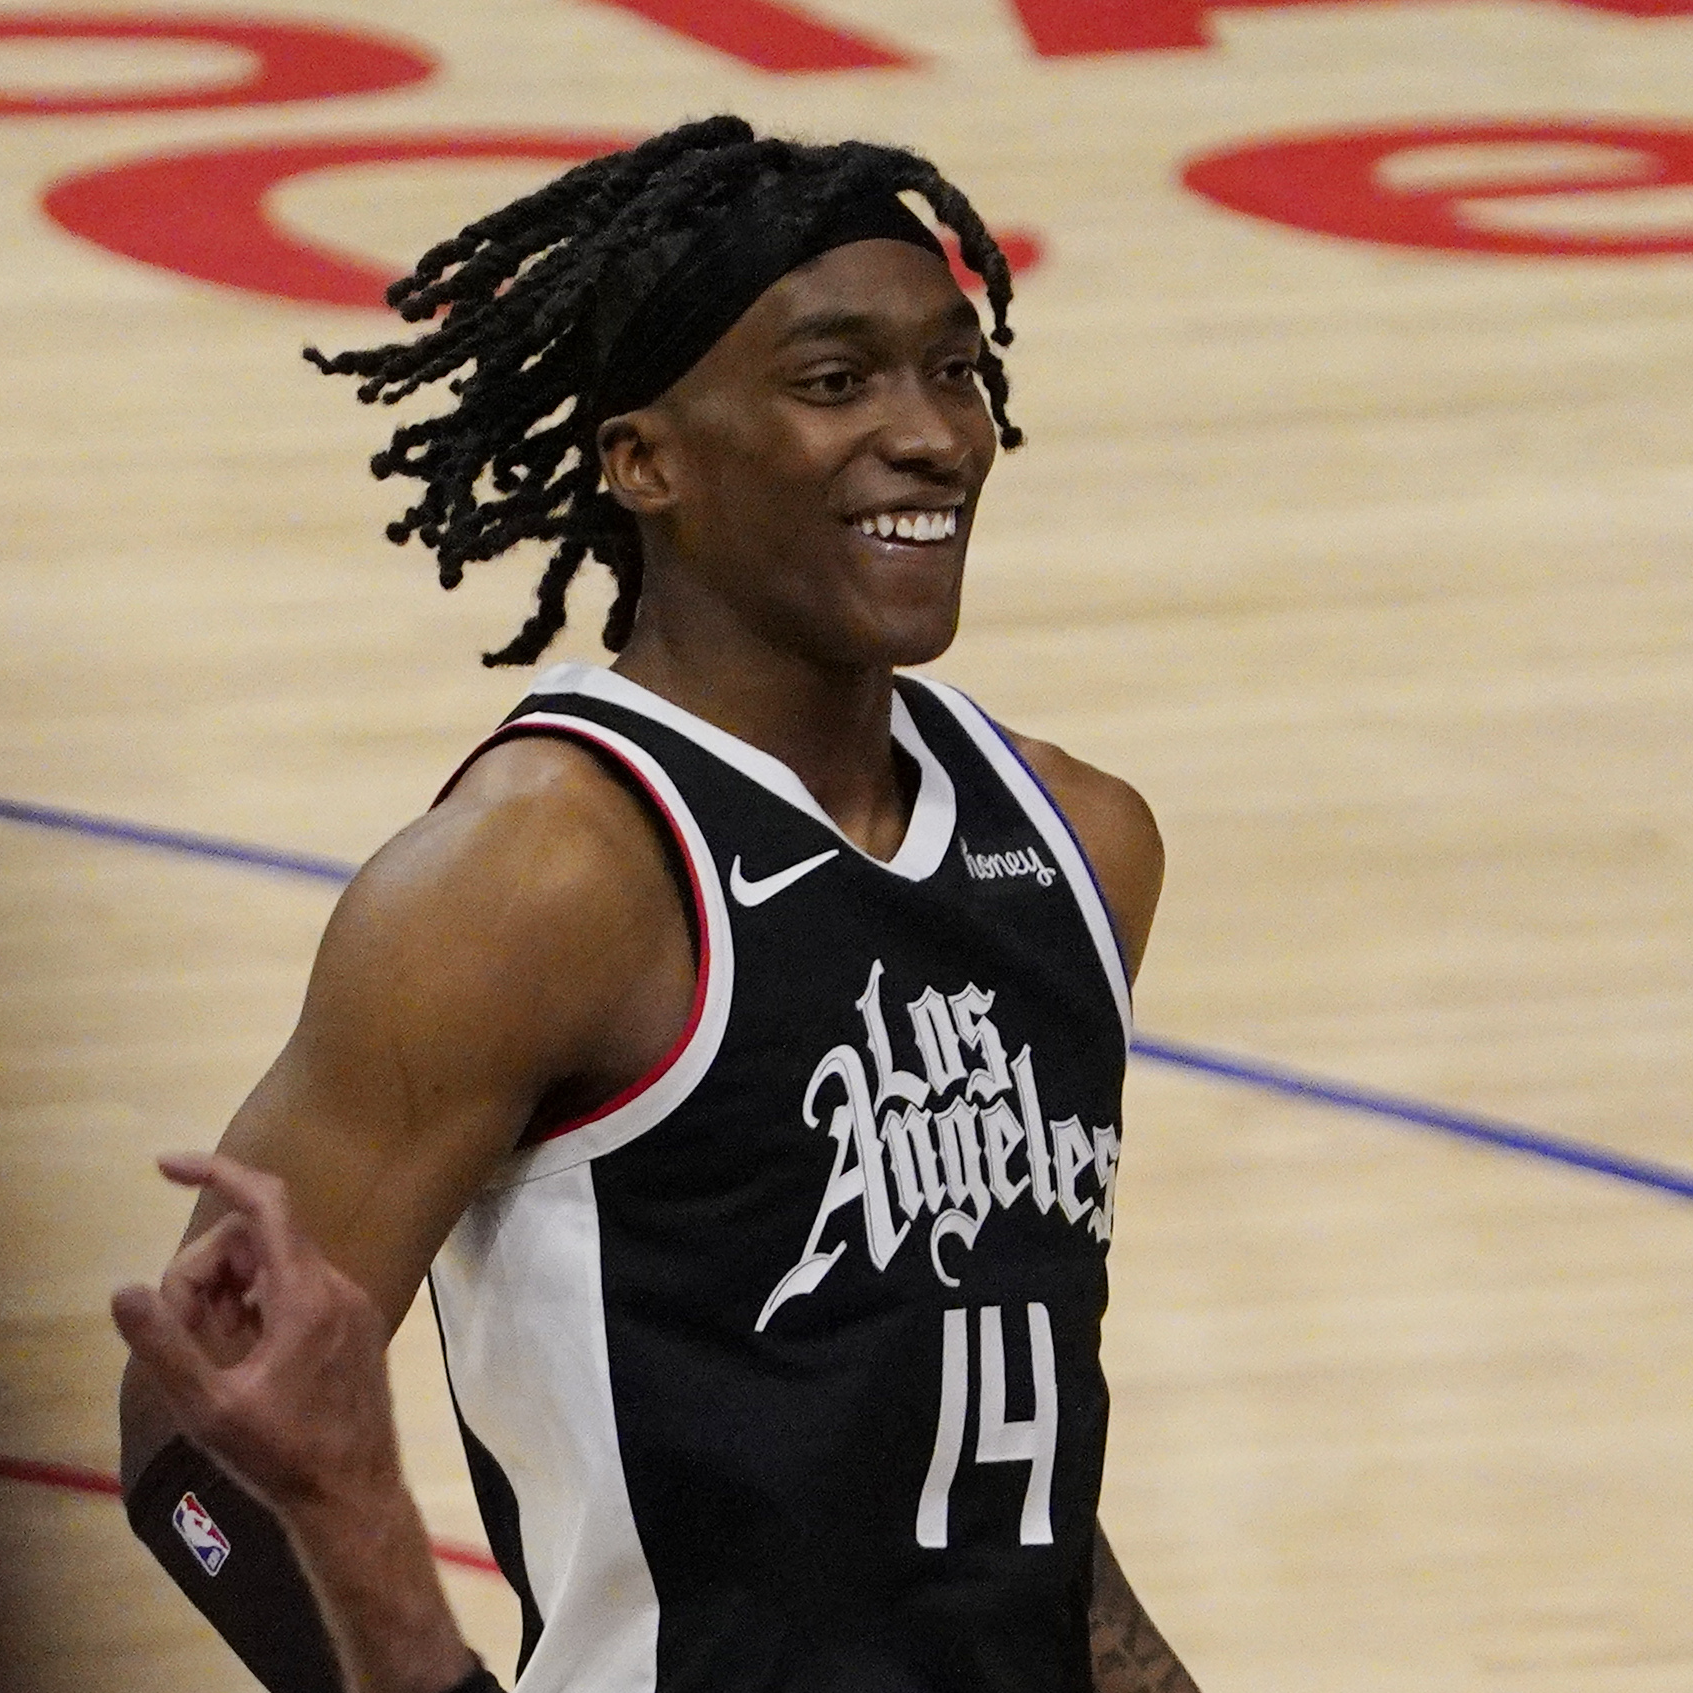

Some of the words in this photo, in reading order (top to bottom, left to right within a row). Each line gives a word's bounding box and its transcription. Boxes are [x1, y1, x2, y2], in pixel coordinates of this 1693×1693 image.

[959, 836, 1057, 888] honey
[855, 957, 1012, 1113] Los
[754, 1043, 1123, 1333] Angeles
[915, 1301, 1059, 1549] 14
